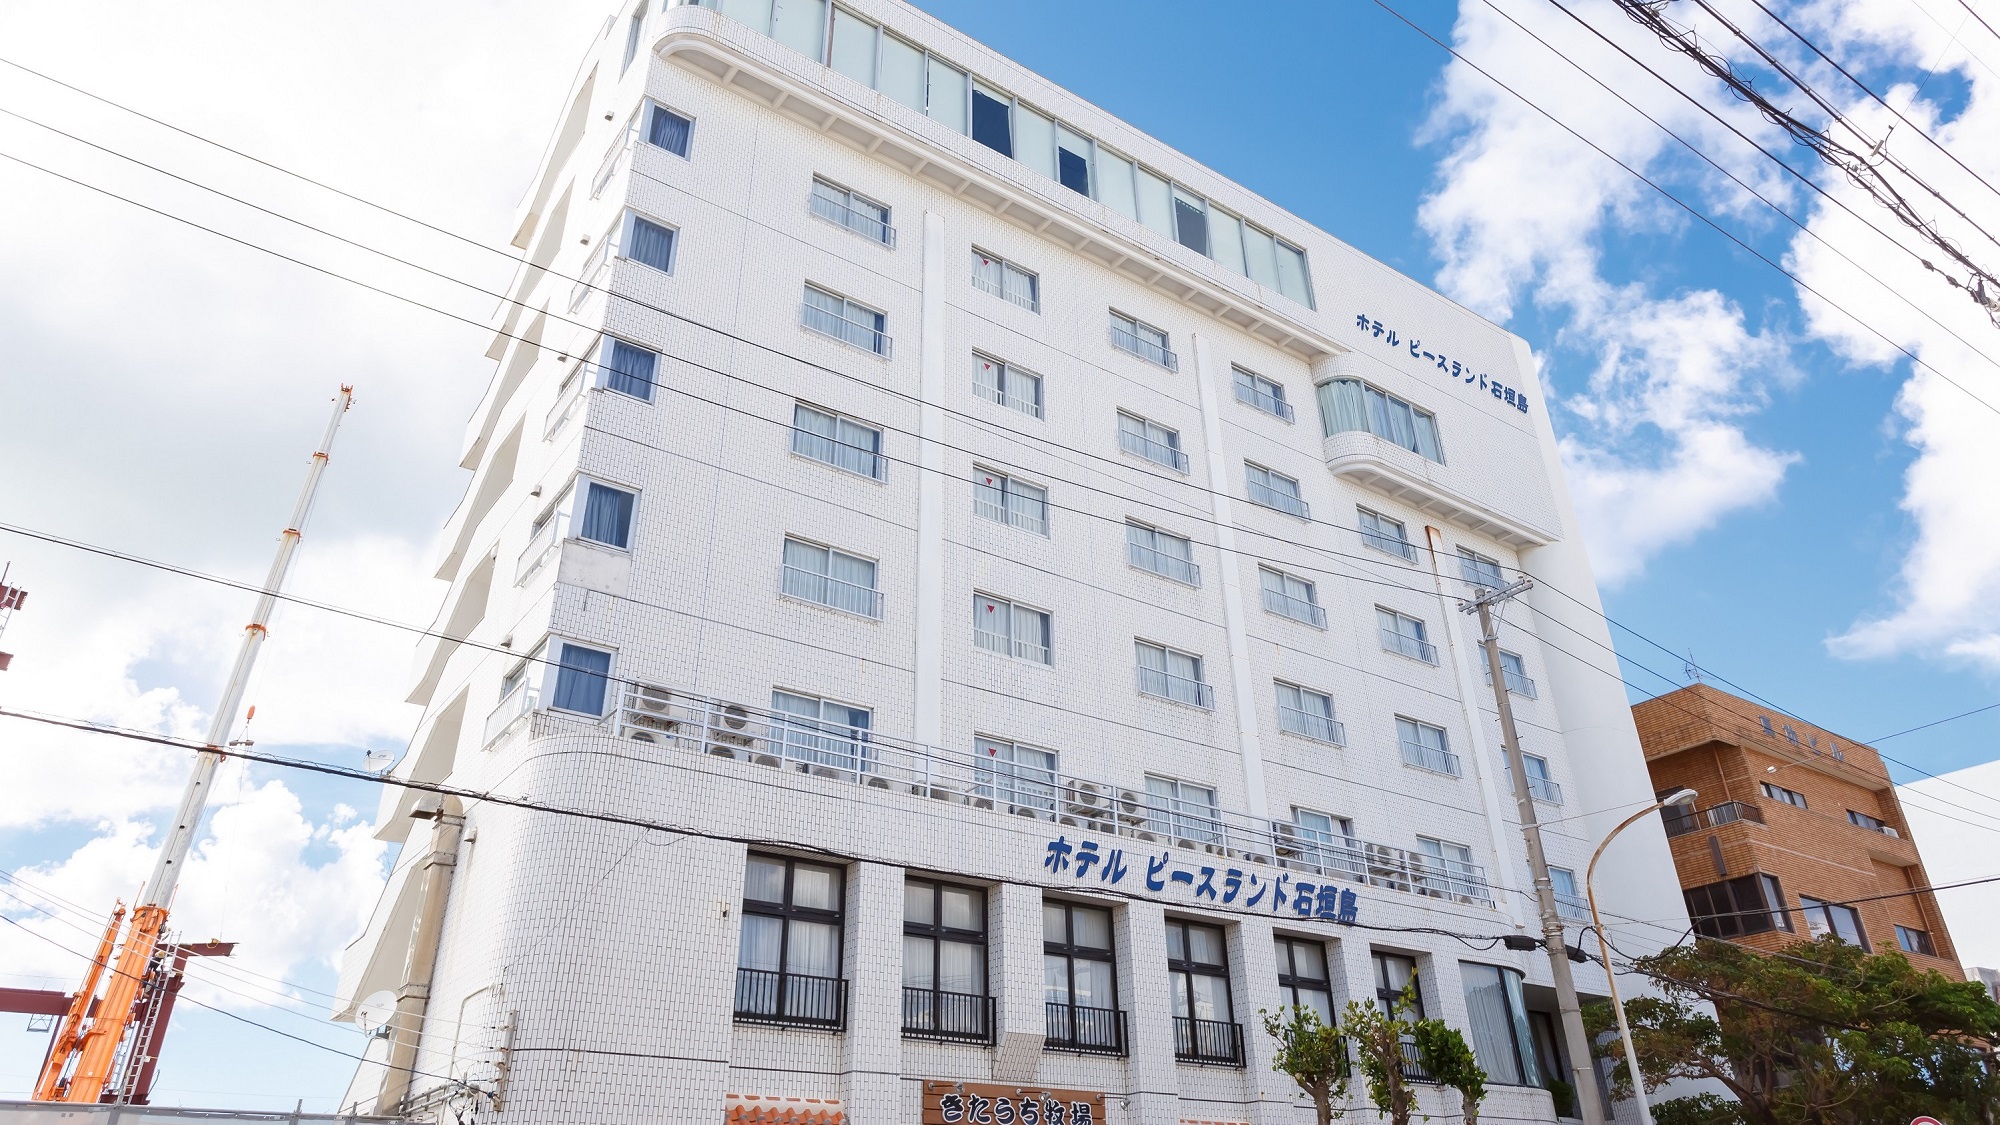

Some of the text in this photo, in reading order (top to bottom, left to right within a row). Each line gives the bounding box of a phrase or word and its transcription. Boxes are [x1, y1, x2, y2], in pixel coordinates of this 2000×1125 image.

[1356, 313, 1529, 414] ホテル ピースランド石垣島
[1044, 835, 1359, 926] ホテル ピースランド石垣島
[940, 1094, 1093, 1125] きたうち牧場
